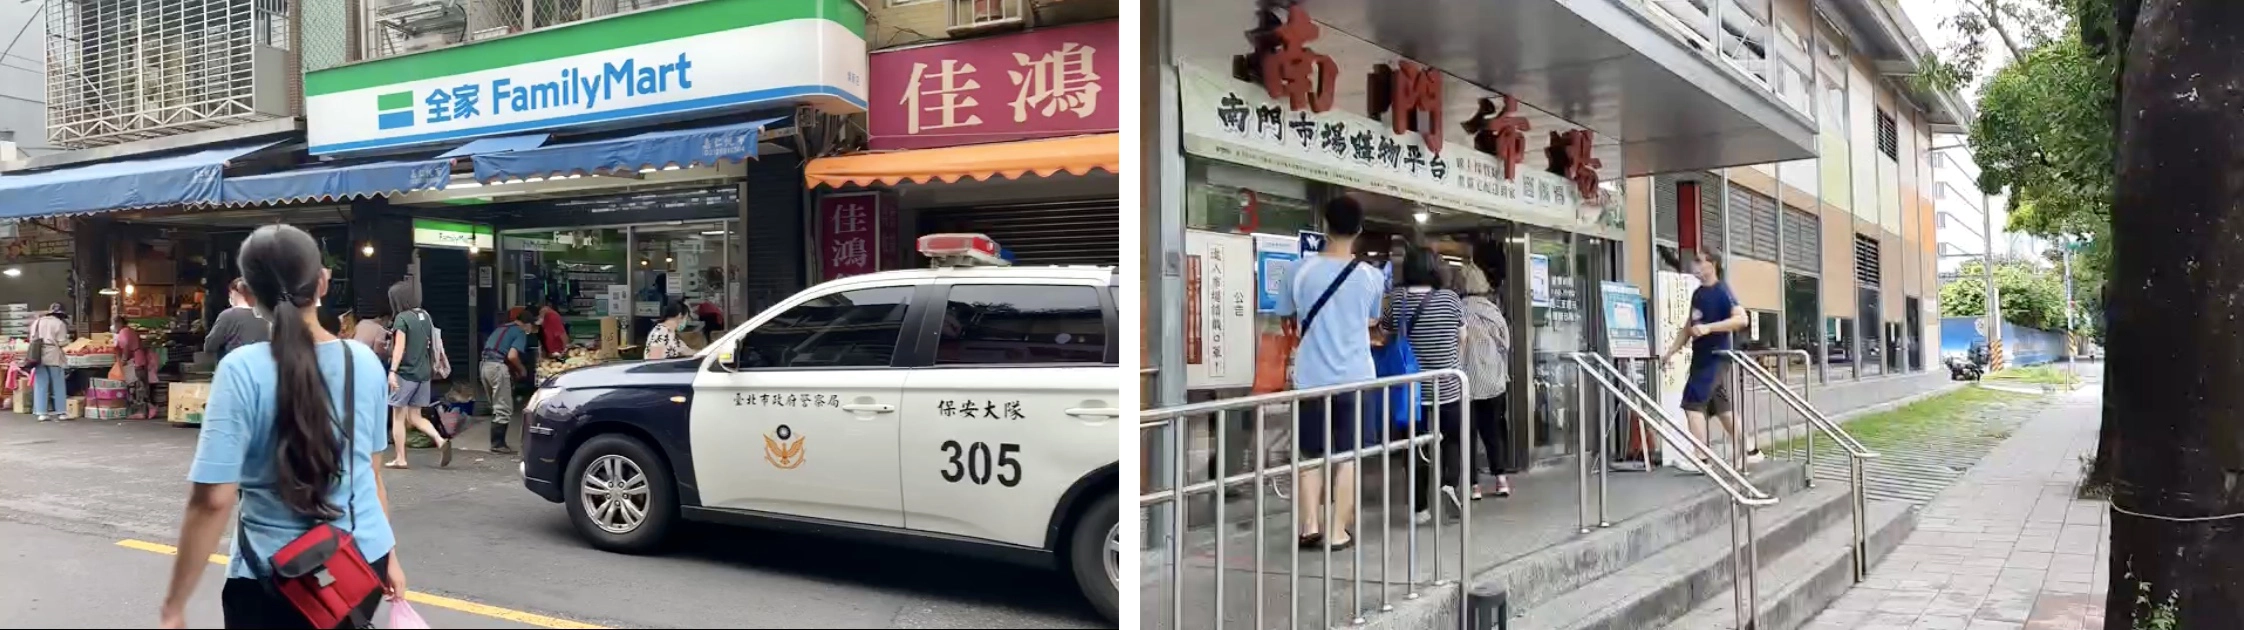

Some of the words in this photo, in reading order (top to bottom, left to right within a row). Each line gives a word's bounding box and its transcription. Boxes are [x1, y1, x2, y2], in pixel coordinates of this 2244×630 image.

[425, 82, 481, 124] 全家
[493, 52, 692, 115] FamilyMart
[899, 42, 1102, 135] 佳鴻
[1240, 2, 1602, 206] 南門市場
[1217, 92, 1447, 180] 南門市場購物平台
[830, 203, 867, 279] 佳鴻
[1237, 187, 1259, 232] 3
[937, 399, 1027, 421] 保安大隊
[939, 439, 1023, 488] 305
